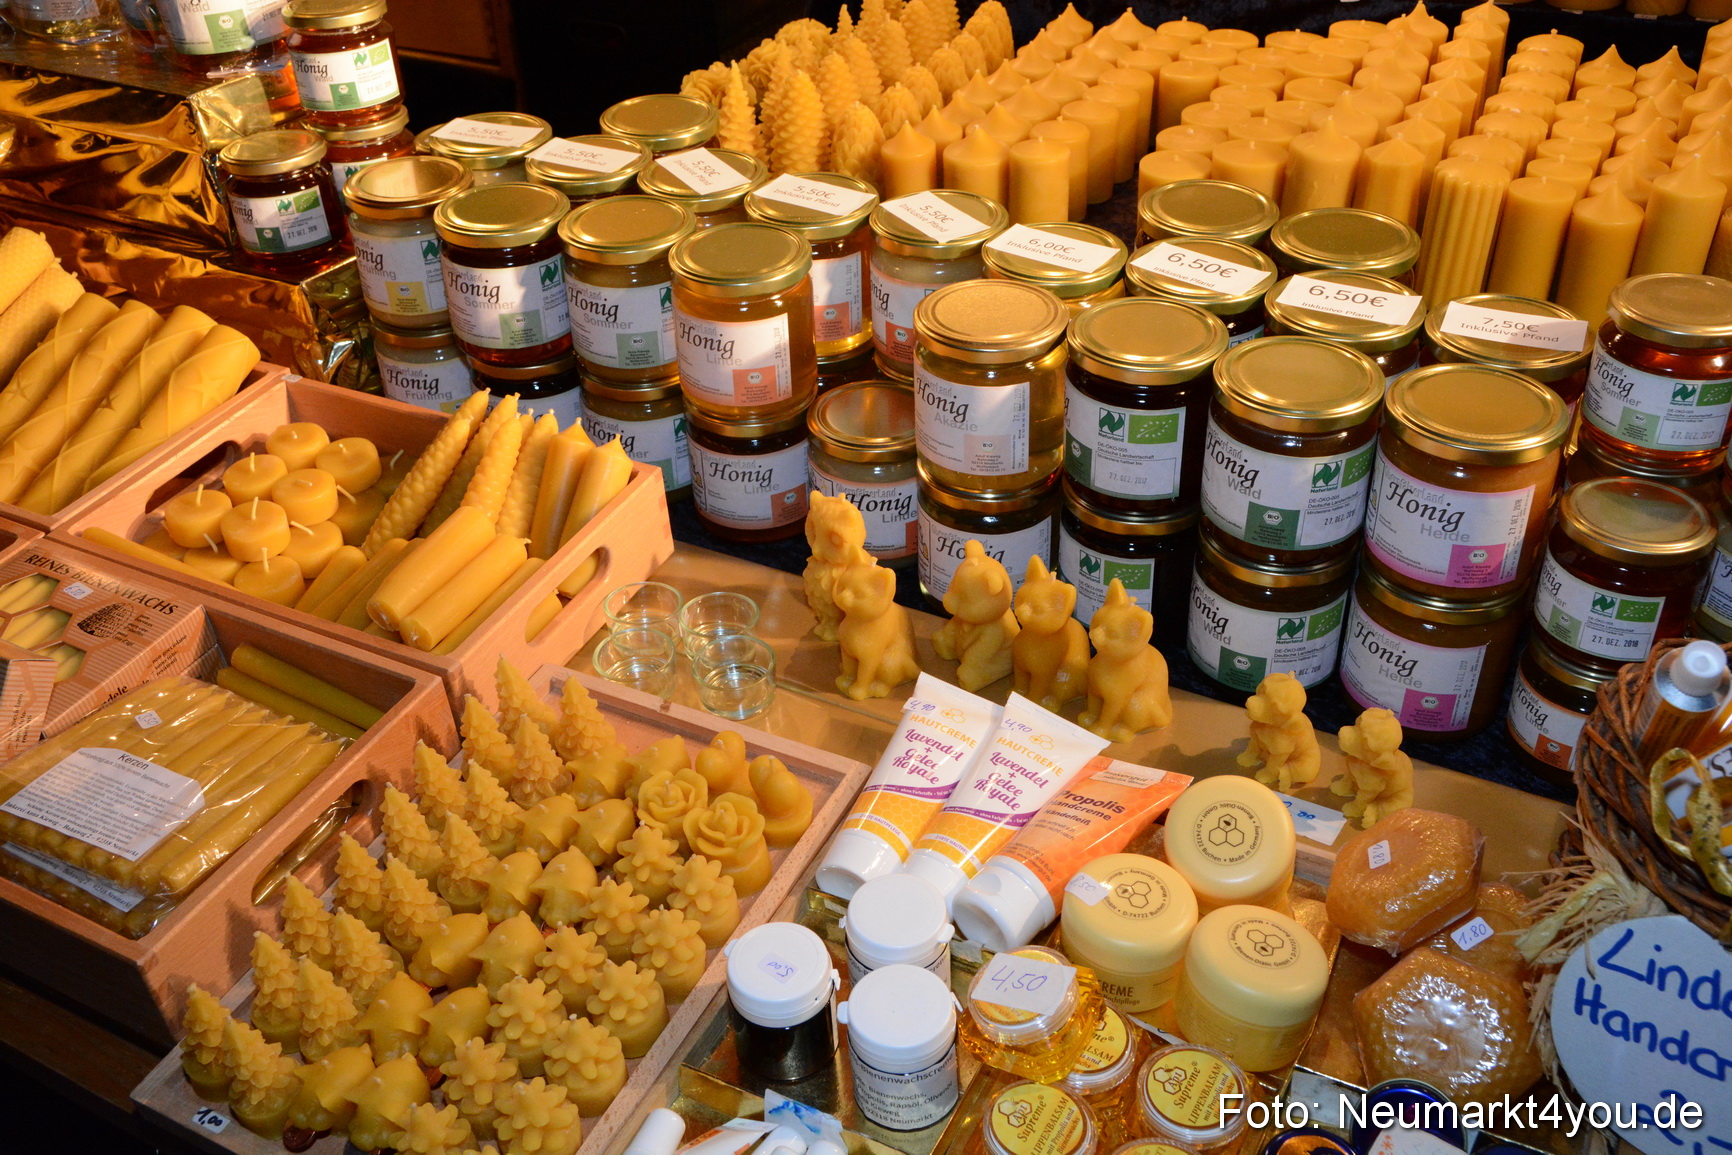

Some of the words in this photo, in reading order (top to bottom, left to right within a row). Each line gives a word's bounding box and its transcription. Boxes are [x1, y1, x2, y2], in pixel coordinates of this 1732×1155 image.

[180, 1, 210, 14] Wald
[295, 60, 328, 77] Honig
[564, 147, 603, 160] 5,50€
[692, 160, 721, 179] 5,50€
[773, 187, 812, 203] Inklusive
[811, 197, 841, 209] Pfand
[794, 185, 836, 200] 5,50€
[900, 202, 931, 225] Inklusive
[919, 204, 955, 227] 5,50€
[1007, 240, 1051, 256] Inklusive
[1053, 253, 1083, 264] Pfand
[1029, 238, 1076, 254] 6,00€
[1167, 252, 1238, 278] 6,50€
[448, 271, 500, 304] Honig
[1153, 266, 1189, 280] Inklusive
[1190, 277, 1216, 288] Pfand
[464, 297, 515, 310] Sommer
[568, 287, 619, 323] Honig
[1308, 284, 1388, 308] 6,50€
[1301, 301, 1344, 315] Inklusive
[1344, 309, 1374, 319] Pfand
[584, 313, 634, 330] Sommer
[1460, 322, 1519, 336] Inklusive
[1522, 331, 1560, 343] Pfand
[1482, 316, 1540, 333] 7,50€
[679, 322, 735, 360] Honig
[706, 352, 742, 366] Linde
[387, 369, 439, 395] Honig
[1594, 356, 1635, 398] Honig
[405, 390, 453, 401] Frühling
[916, 377, 969, 423] Honig
[1600, 382, 1642, 407] Sommer
[934, 412, 978, 433] Akazie
[1206, 432, 1260, 489] Honig
[709, 462, 773, 488] Honig
[1109, 471, 1119, 482] 27.
[744, 482, 780, 495] Linde
[1227, 476, 1262, 501] Wald
[1310, 486, 1338, 494] Naturland
[845, 492, 913, 516] Honig
[1307, 501, 1331, 510] Deutsche
[1386, 481, 1465, 533] Honig
[882, 509, 917, 524] Linde
[1324, 517, 1334, 526] 27.
[1420, 523, 1470, 543] Heide
[25, 553, 72, 576] REINES
[71, 570, 178, 616] BIENENWACHS
[1190, 586, 1230, 635] Honig
[1203, 621, 1232, 646] Wald
[1592, 634, 1604, 645] 27.
[1605, 636, 1621, 647] DEZ.
[1623, 639, 1639, 648] 2018
[1353, 621, 1419, 678] Honig
[1378, 664, 1423, 689] Heide
[909, 699, 936, 717] 4,90
[1515, 685, 1548, 726] Honig
[909, 713, 978, 749] HAUTCREME
[1004, 718, 1033, 733] 4,90
[1525, 712, 1549, 735] Linde
[905, 728, 965, 762] Lavendel
[117, 753, 149, 770] Kerzen
[904, 748, 939, 771] Gelee
[996, 737, 1064, 777] HAUTCREME
[893, 755, 940, 785] Royale
[989, 752, 1049, 789] Lavendel
[976, 779, 1021, 812] Royale
[987, 772, 1023, 797] Gelee
[1057, 790, 1126, 814] Propolis
[1202, 805, 1218, 819] GmbH
[873, 815, 901, 836] HAUTPFLEGE
[1044, 809, 1091, 826] Händefleiß
[6, 801, 26, 812] Imkerei
[25, 809, 39, 817] Anna
[63, 823, 86, 837] Bahnweg
[95, 835, 111, 848] 92318
[111, 841, 140, 857] Neumarkt
[1196, 823, 1204, 847] D-74722
[1249, 825, 1261, 851] Germany
[1201, 847, 1222, 863] Buchen
[1228, 854, 1245, 863] Made
[1130, 869, 1156, 881] Germany
[1122, 910, 1149, 919] D-74722
[1149, 902, 1167, 917] Buchen
[1271, 923, 1291, 938] Buchen
[1273, 959, 1291, 967] GmbH
[990, 964, 1048, 993] 4,50
[1168, 1072, 1183, 1091] Api
[857, 1084, 888, 1107] Propolis,
[889, 1101, 923, 1110] Rapsöl,
[924, 1081, 953, 1104] Olivenöl
[868, 1085, 927, 1101] Bienenwachs,
[1188, 1062, 1223, 1125] LIPPENBALSAM
[1207, 1087, 1223, 1109] Propolis
[864, 1105, 889, 1121] 92318
[889, 1113, 933, 1125] Neumarkt
[1012, 1104, 1028, 1124] Api
[1204, 1110, 1212, 1122] mit
[1031, 1096, 1069, 1155] LIPPENBALSAM
[1050, 1120, 1069, 1146] Propolis
[1064, 1107, 1076, 1124] und
[1056, 1117, 1081, 1154] Bienenwachs
